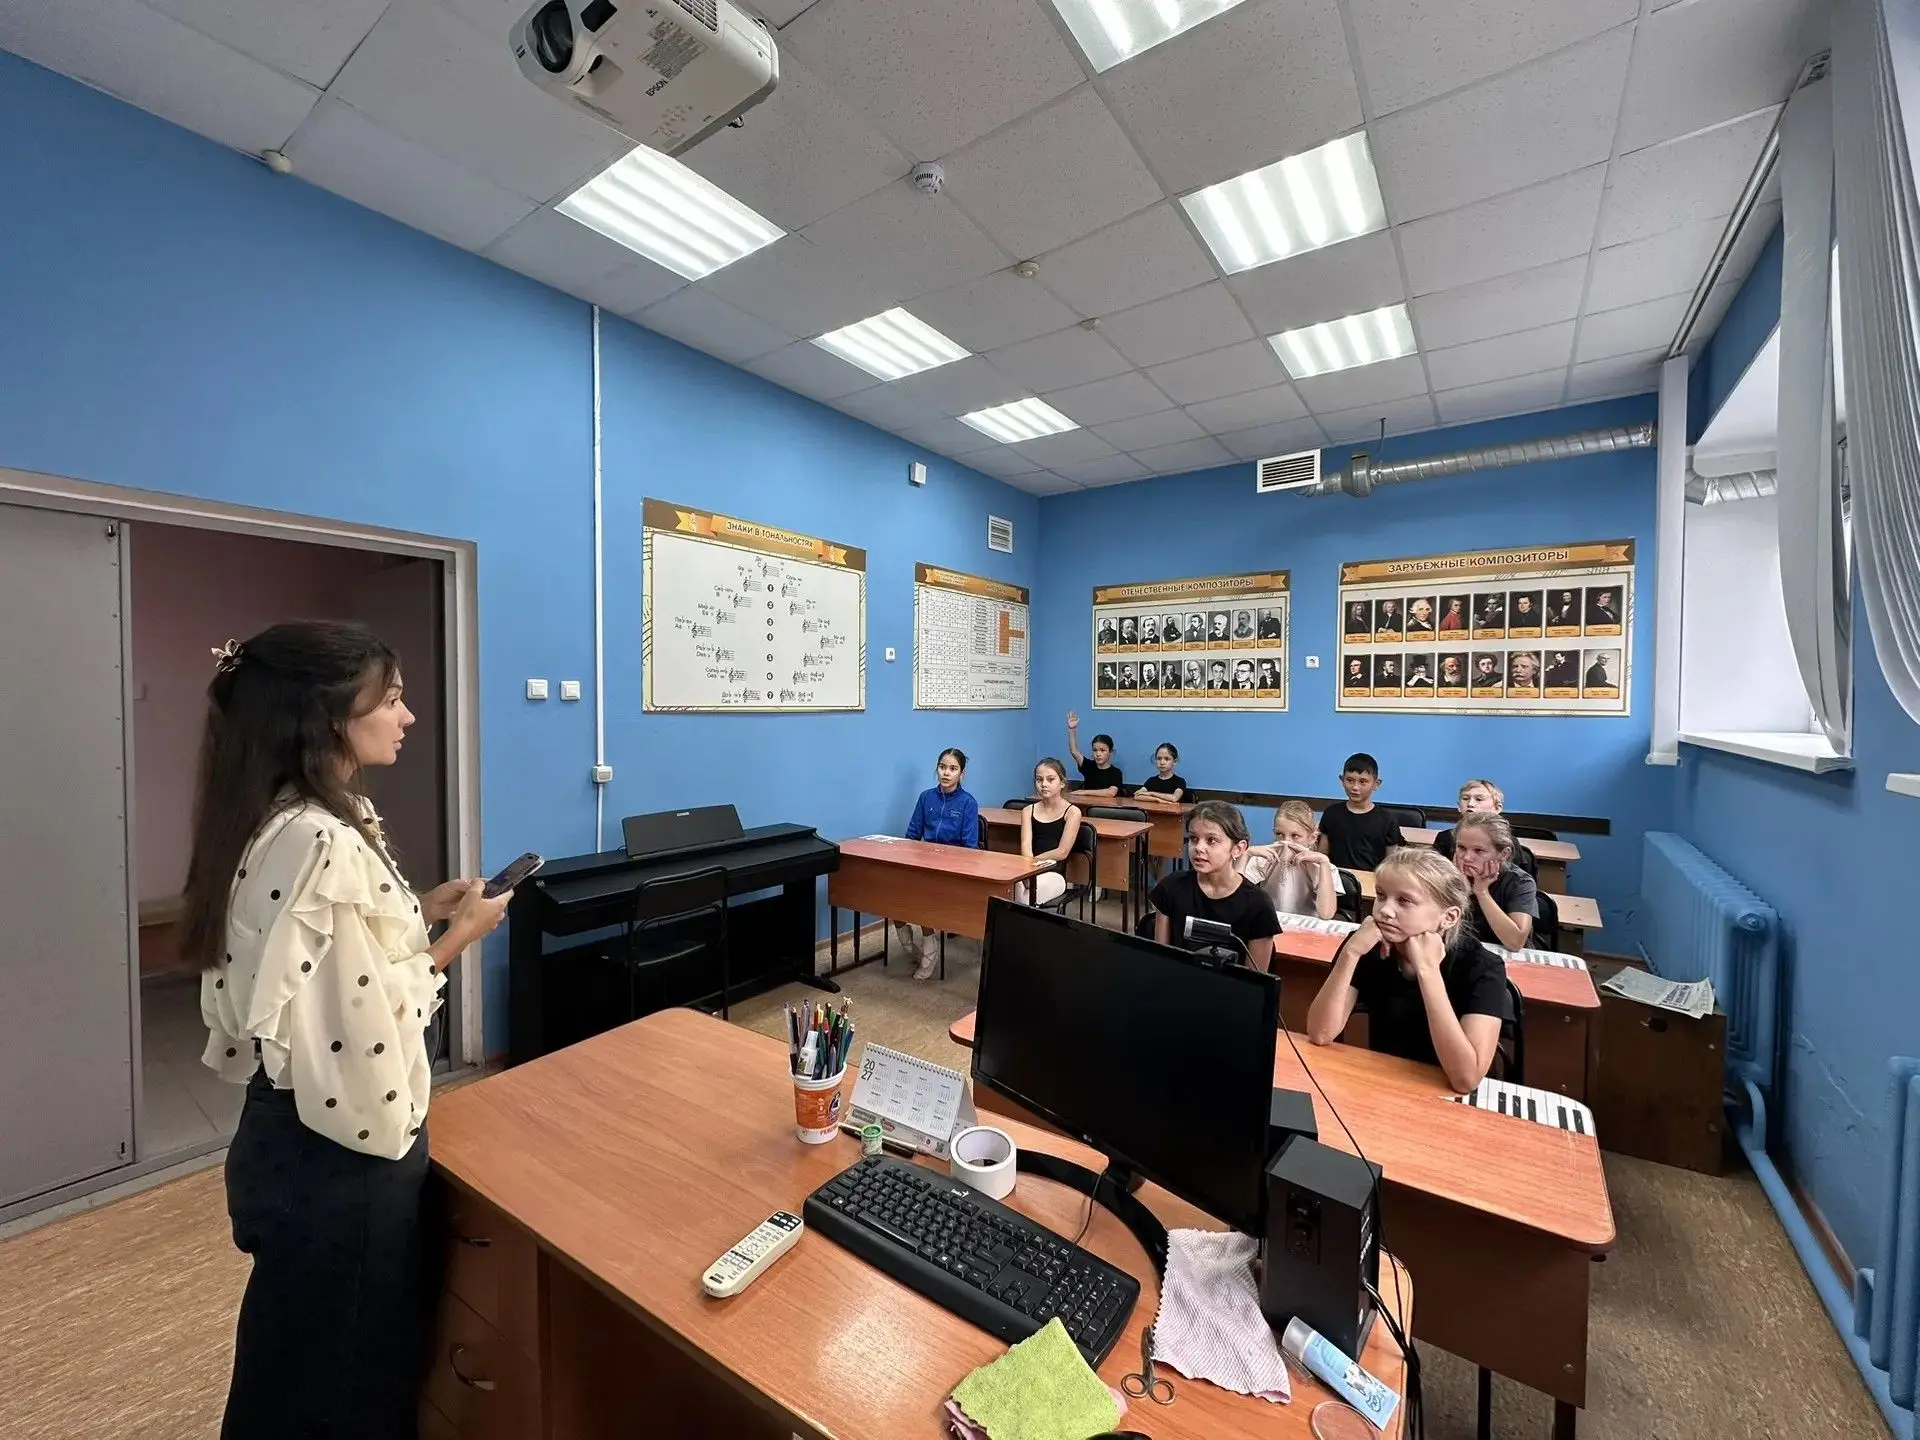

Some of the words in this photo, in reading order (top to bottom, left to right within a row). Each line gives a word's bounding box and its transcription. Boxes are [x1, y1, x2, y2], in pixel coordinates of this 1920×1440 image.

[645, 78, 669, 97] EPSON
[727, 521, 753, 535] ЗНАКИ
[754, 527, 760, 536] В
[762, 529, 814, 548] ТОНАЛЬНОСТЯХ
[1387, 557, 1466, 574] ЗАРУБЕЖНЫЕ
[1469, 549, 1569, 568] КОМПОЗИТОРЫ
[1120, 583, 1187, 597] ОТЕЧЕСТВЕННЫЕ
[1187, 577, 1255, 591] КОМПОЗИТОРЫ
[864, 1058, 875, 1071] 20
[861, 1069, 873, 1082] 27
